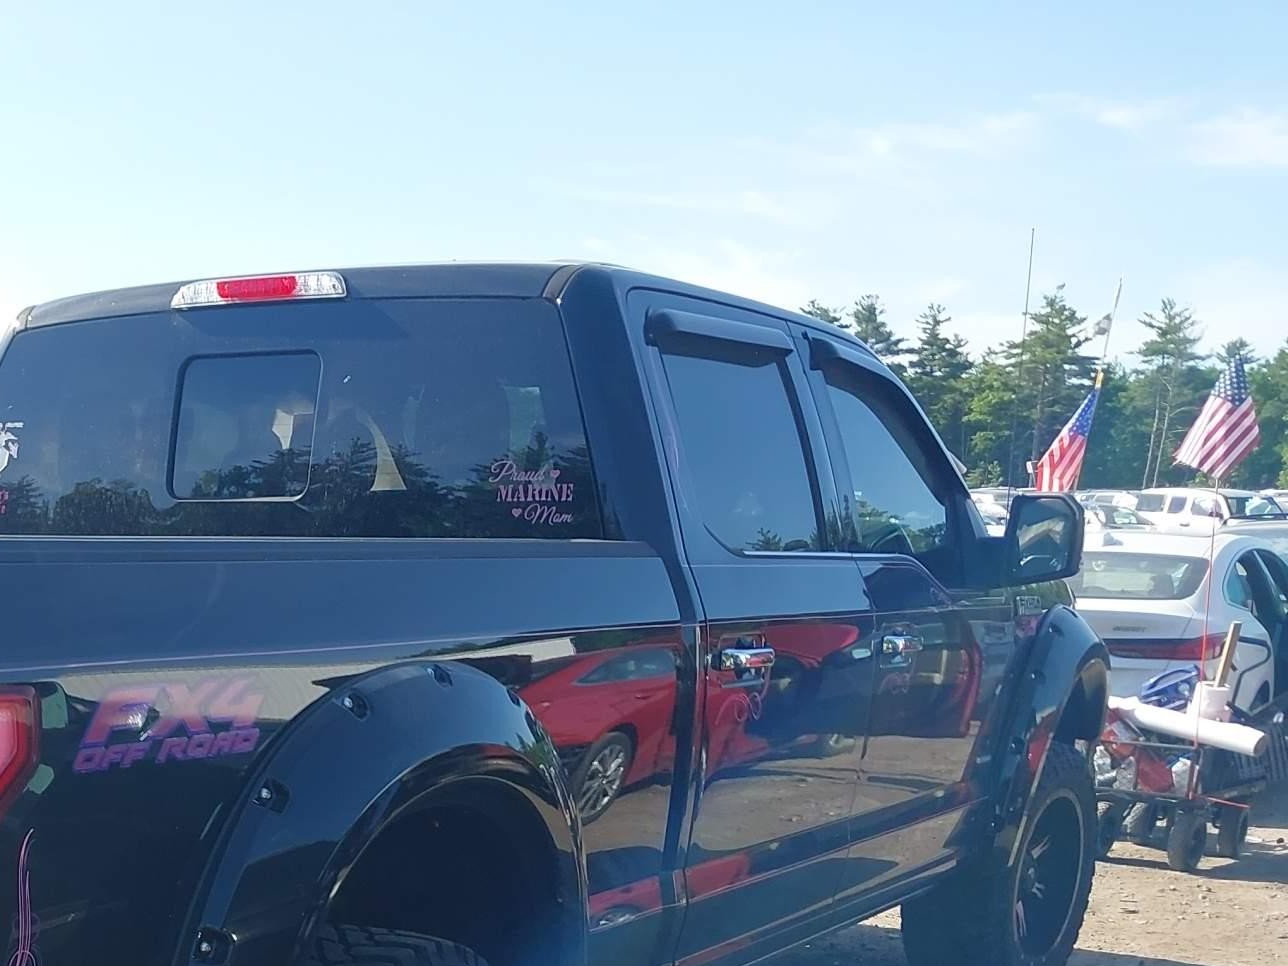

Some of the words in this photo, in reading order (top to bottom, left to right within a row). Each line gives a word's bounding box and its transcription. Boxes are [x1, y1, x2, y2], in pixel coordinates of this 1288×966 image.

[489, 460, 545, 482] Proud
[497, 483, 574, 502] MARINE
[524, 503, 573, 525] Mom
[80, 674, 263, 748] FX4
[72, 742, 153, 774] OFF
[155, 727, 260, 764] ROAD
